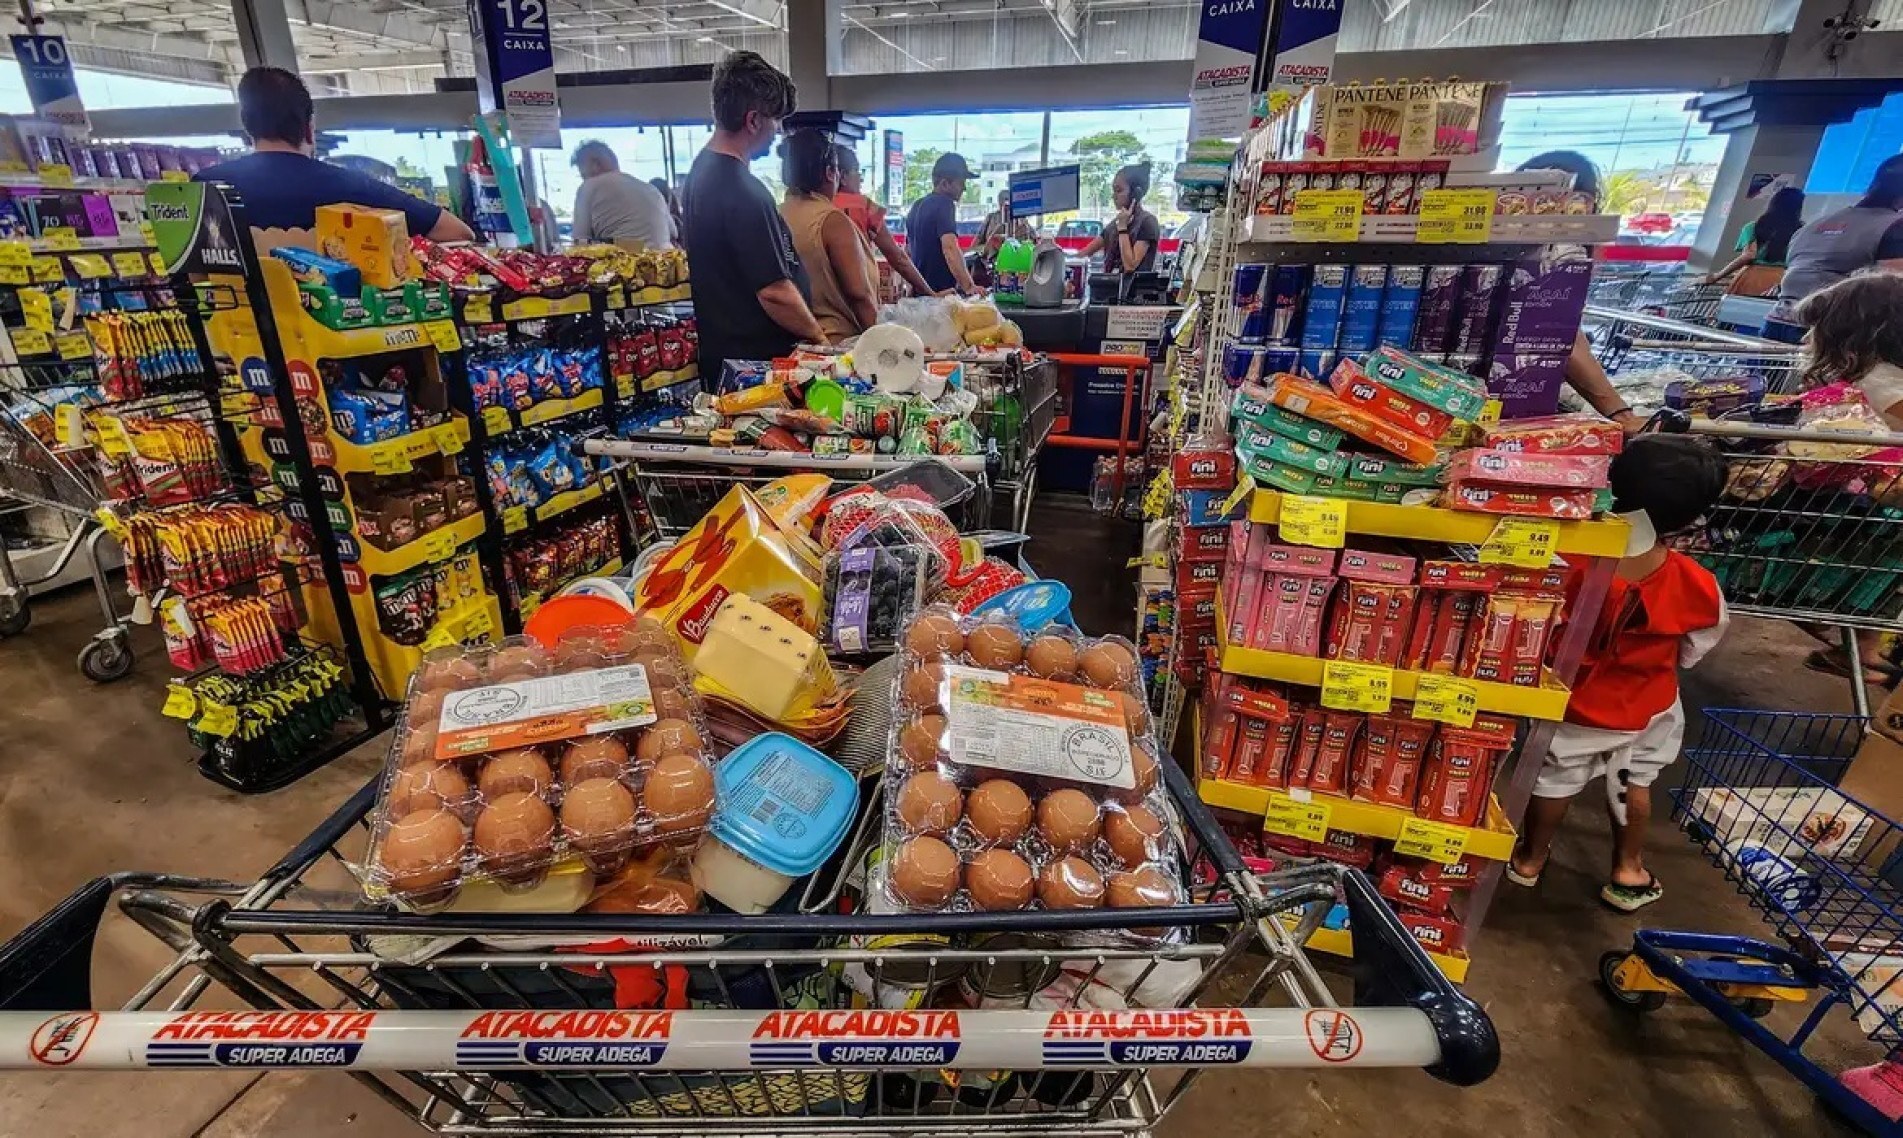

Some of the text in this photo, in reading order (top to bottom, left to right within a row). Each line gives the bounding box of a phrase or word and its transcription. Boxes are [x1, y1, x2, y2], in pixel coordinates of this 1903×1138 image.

[498, 0, 545, 29] 12
[1209, 0, 1255, 16] CAIXA
[1293, 0, 1336, 10] CAIXA
[23, 39, 64, 63] 10
[503, 41, 545, 50] CAIXA
[1336, 88, 1405, 103] PANTENE
[1410, 83, 1480, 100] PANTENE
[150, 204, 189, 218] Trident
[201, 249, 237, 266] HALLS
[1502, 302, 1523, 344] Red Bull
[247, 366, 271, 387] m
[291, 370, 314, 389] m
[269, 436, 290, 455] m
[280, 469, 301, 488] m
[152, 1012, 376, 1039] ATACADISTA
[461, 1011, 673, 1038] ATACADISTA
[751, 1010, 962, 1038] ATACADISTA
[1043, 1010, 1251, 1038] ATACADISTA
[229, 1045, 346, 1066] SUPER ADEGA
[537, 1045, 652, 1065] SUPER ADEGA
[830, 1044, 946, 1064] SUPER ADEGA
[1122, 1044, 1238, 1064] SUPER ADEGA
